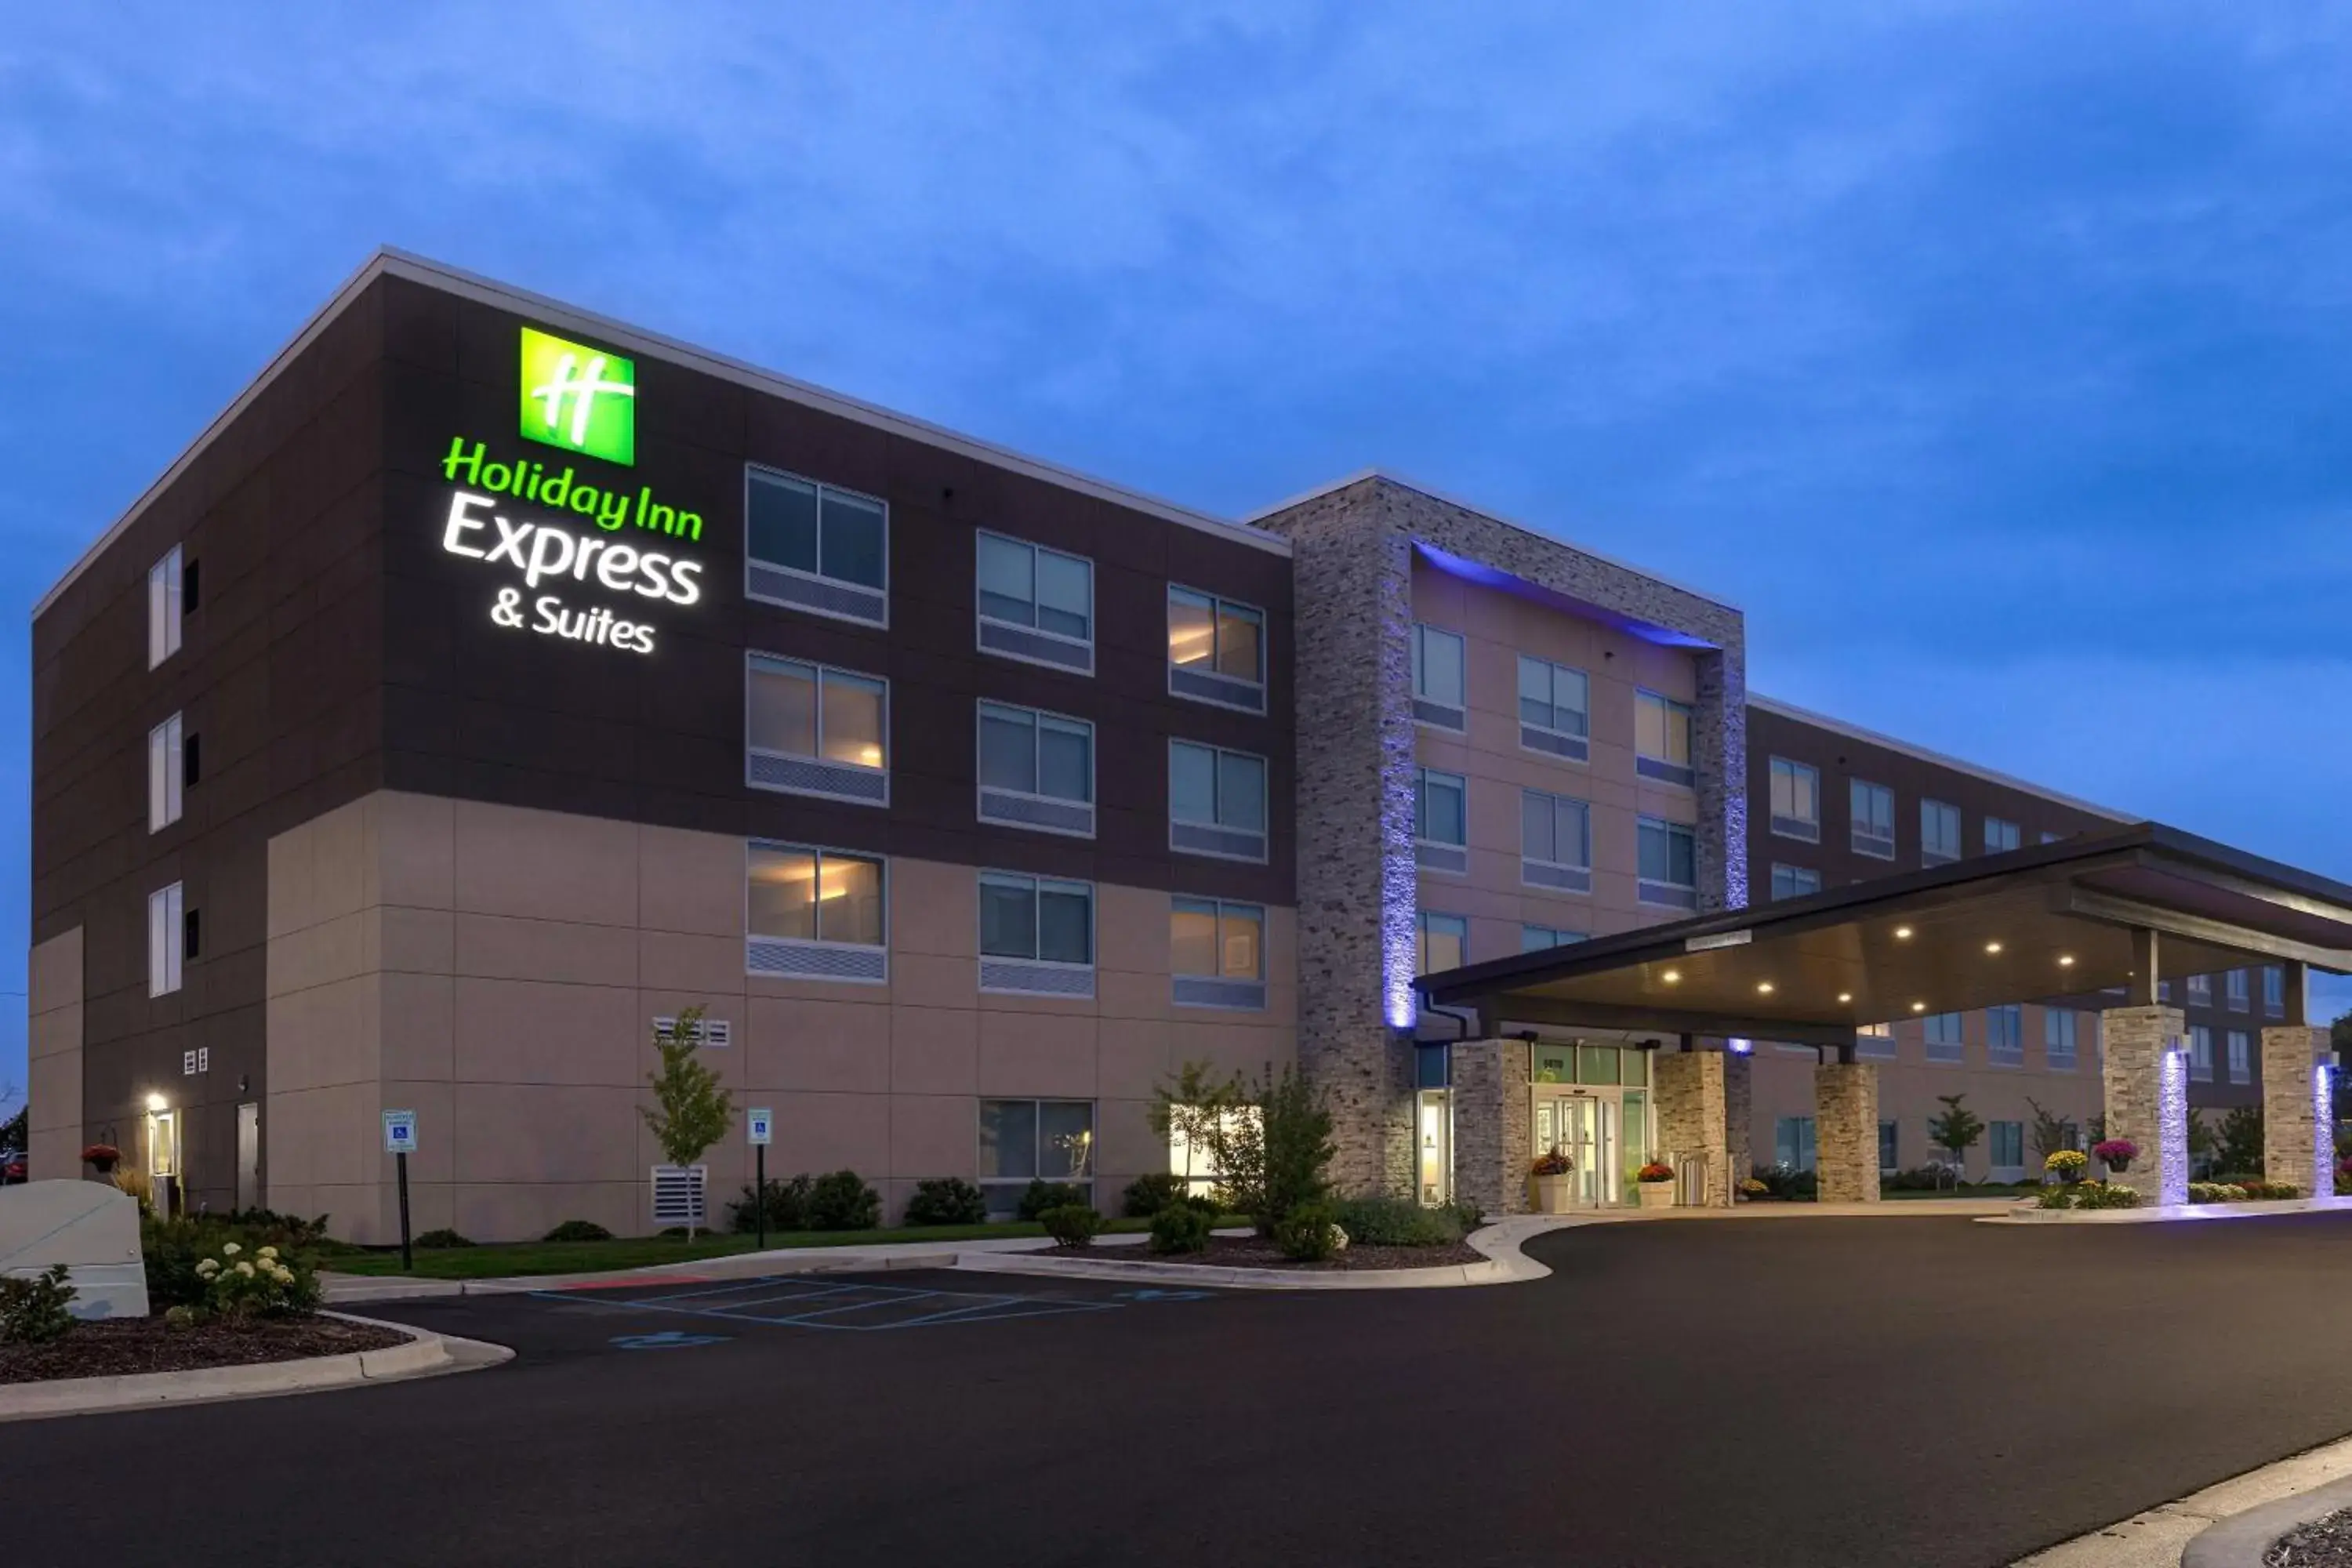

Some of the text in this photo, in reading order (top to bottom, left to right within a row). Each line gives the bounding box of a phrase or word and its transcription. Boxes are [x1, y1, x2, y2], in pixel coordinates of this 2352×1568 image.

[442, 437, 703, 542] Holiday Inn
[442, 491, 703, 605] Express
[490, 587, 656, 654] & Suites
